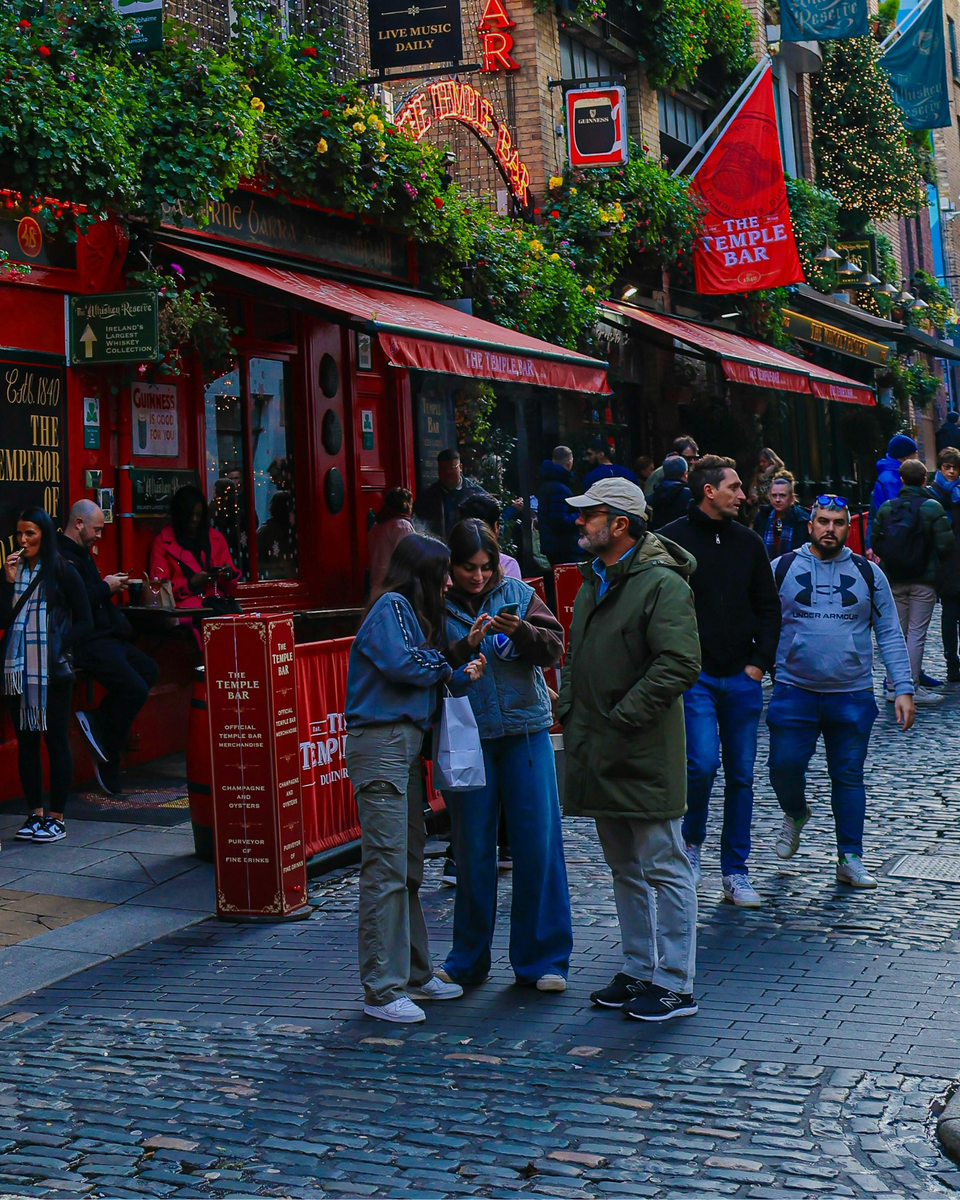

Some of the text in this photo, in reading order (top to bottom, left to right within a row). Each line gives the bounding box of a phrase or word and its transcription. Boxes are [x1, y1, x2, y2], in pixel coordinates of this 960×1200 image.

[378, 23, 451, 40] LIVE MUSIC
[395, 39, 434, 52] DAILY
[578, 116, 610, 125] GUINNESS
[427, 79, 530, 207] TEMPLE BAR
[723, 216, 759, 233] THE
[20, 223, 37, 248] 48
[699, 223, 788, 253] TEMPLE
[723, 246, 770, 267] BAR
[84, 303, 120, 320] Whiskey
[121, 301, 152, 317] Reserve
[106, 324, 144, 332] IRELAND'S
[106, 346, 152, 354] COLLECTION
[464, 348, 534, 377] THE TEMPLE BAR
[37, 376, 60, 406] 1840
[133, 387, 175, 410] GUINNESS
[149, 413, 173, 425] IS GOOD
[30, 414, 59, 447] THE
[150, 429, 174, 440] FOR YOU
[43, 486, 59, 518] OF
[277, 643, 287, 651] THE
[272, 652, 293, 664] TEMPLE
[278, 665, 289, 676] BAR
[216, 680, 260, 689] TEMPLE
[228, 690, 250, 700] BAR
